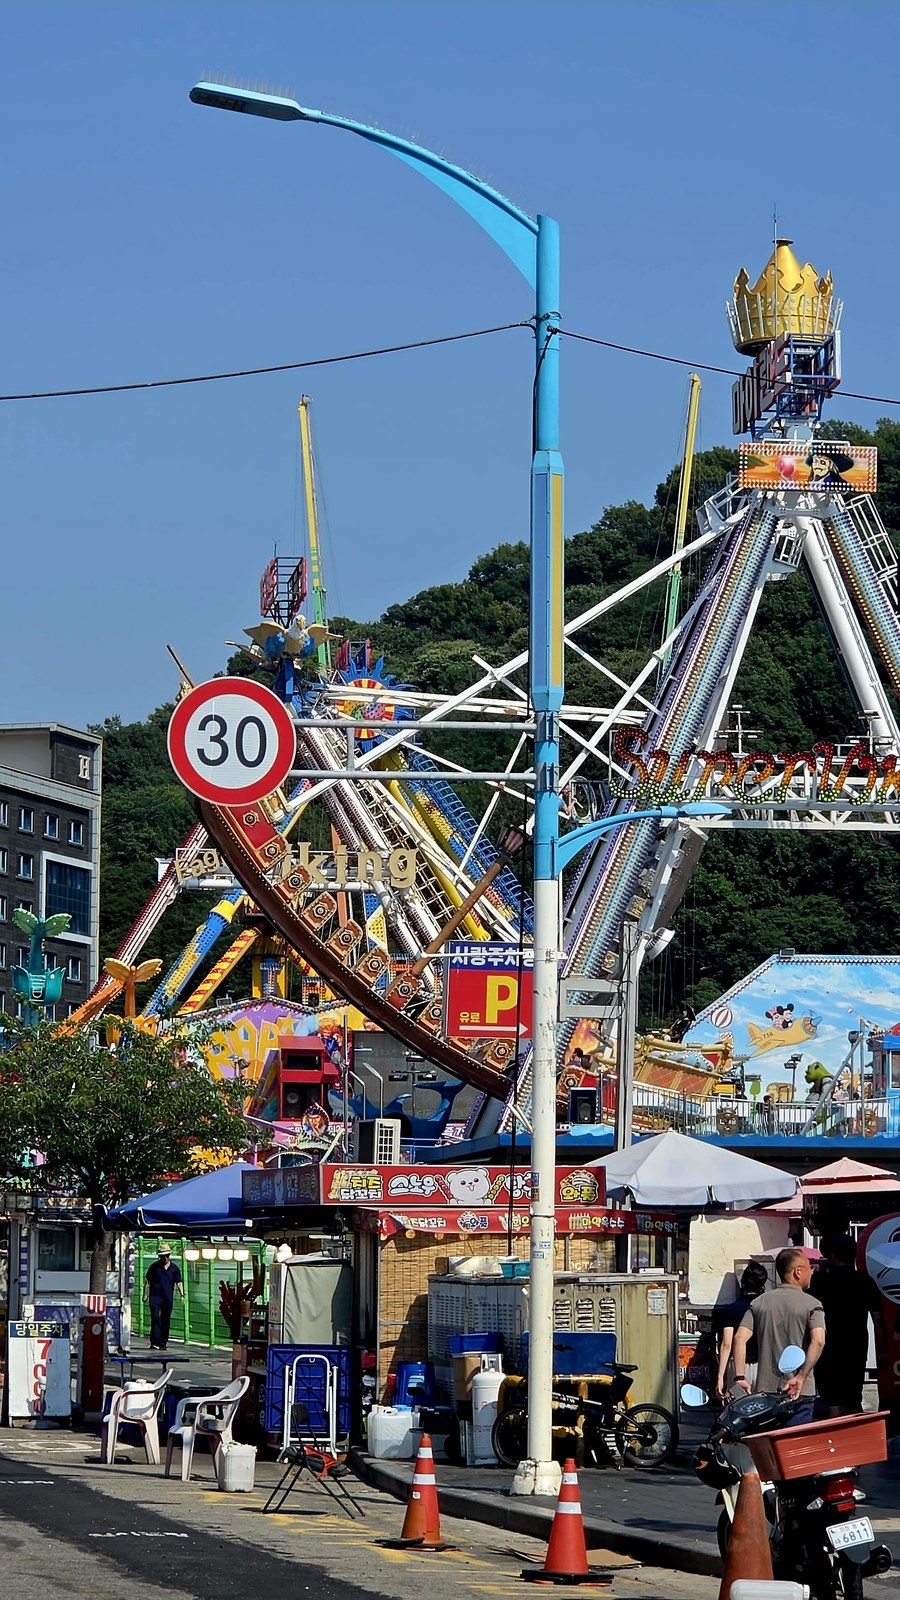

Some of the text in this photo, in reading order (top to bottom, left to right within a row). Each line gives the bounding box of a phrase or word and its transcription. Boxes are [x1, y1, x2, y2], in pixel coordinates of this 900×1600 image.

[197, 714, 267, 768] 30
[485, 975, 519, 1024] P
[459, 1011, 480, 1023] 유료
[389, 1173, 437, 1197] 스노우
[561, 1185, 596, 1201] 와플
[15, 1323, 65, 1337] 당일주차
[842, 1527, 870, 1543] 6811
